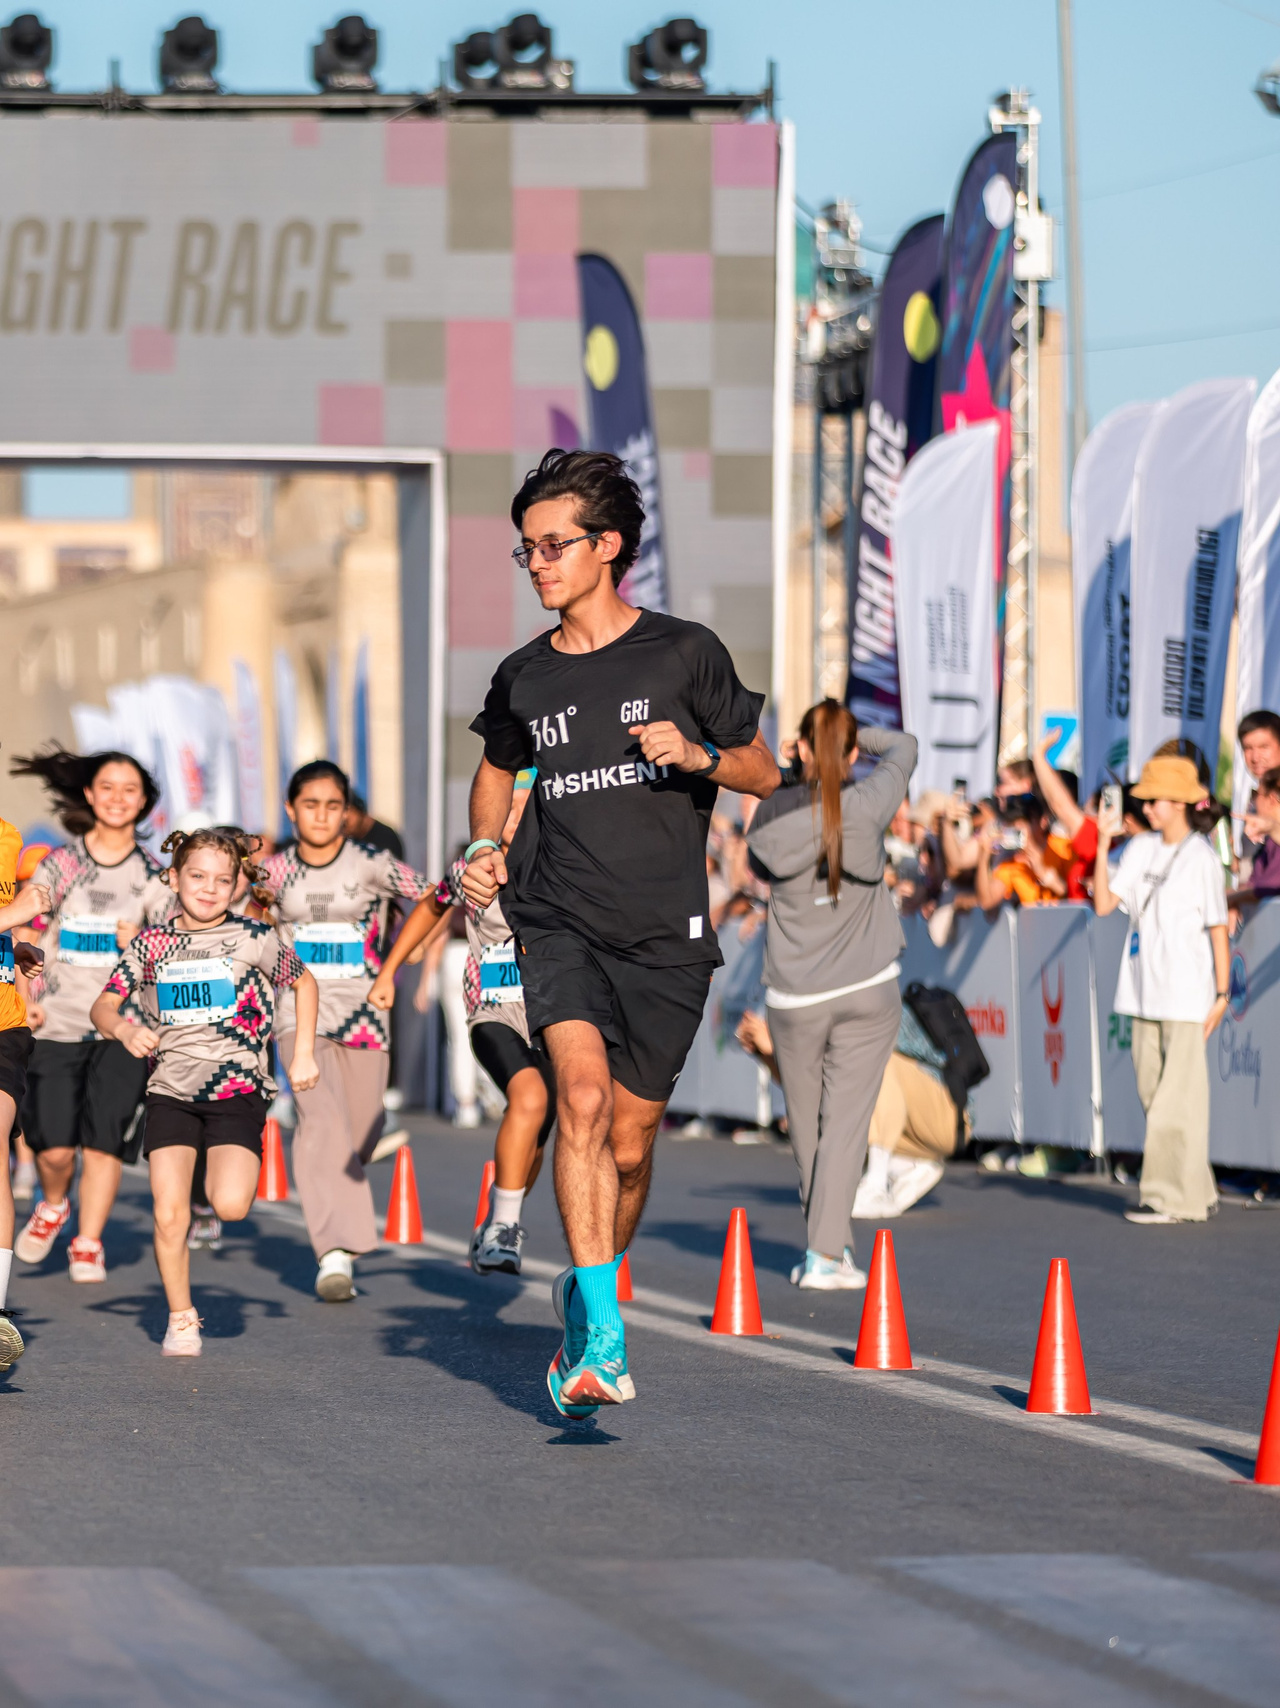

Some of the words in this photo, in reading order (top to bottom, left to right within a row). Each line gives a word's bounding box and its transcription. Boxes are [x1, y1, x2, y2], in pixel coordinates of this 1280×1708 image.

[164, 218, 363, 339] RACE
[861, 399, 908, 538] RACE
[851, 533, 899, 695] NIGHT
[172, 982, 212, 1009] 2048
